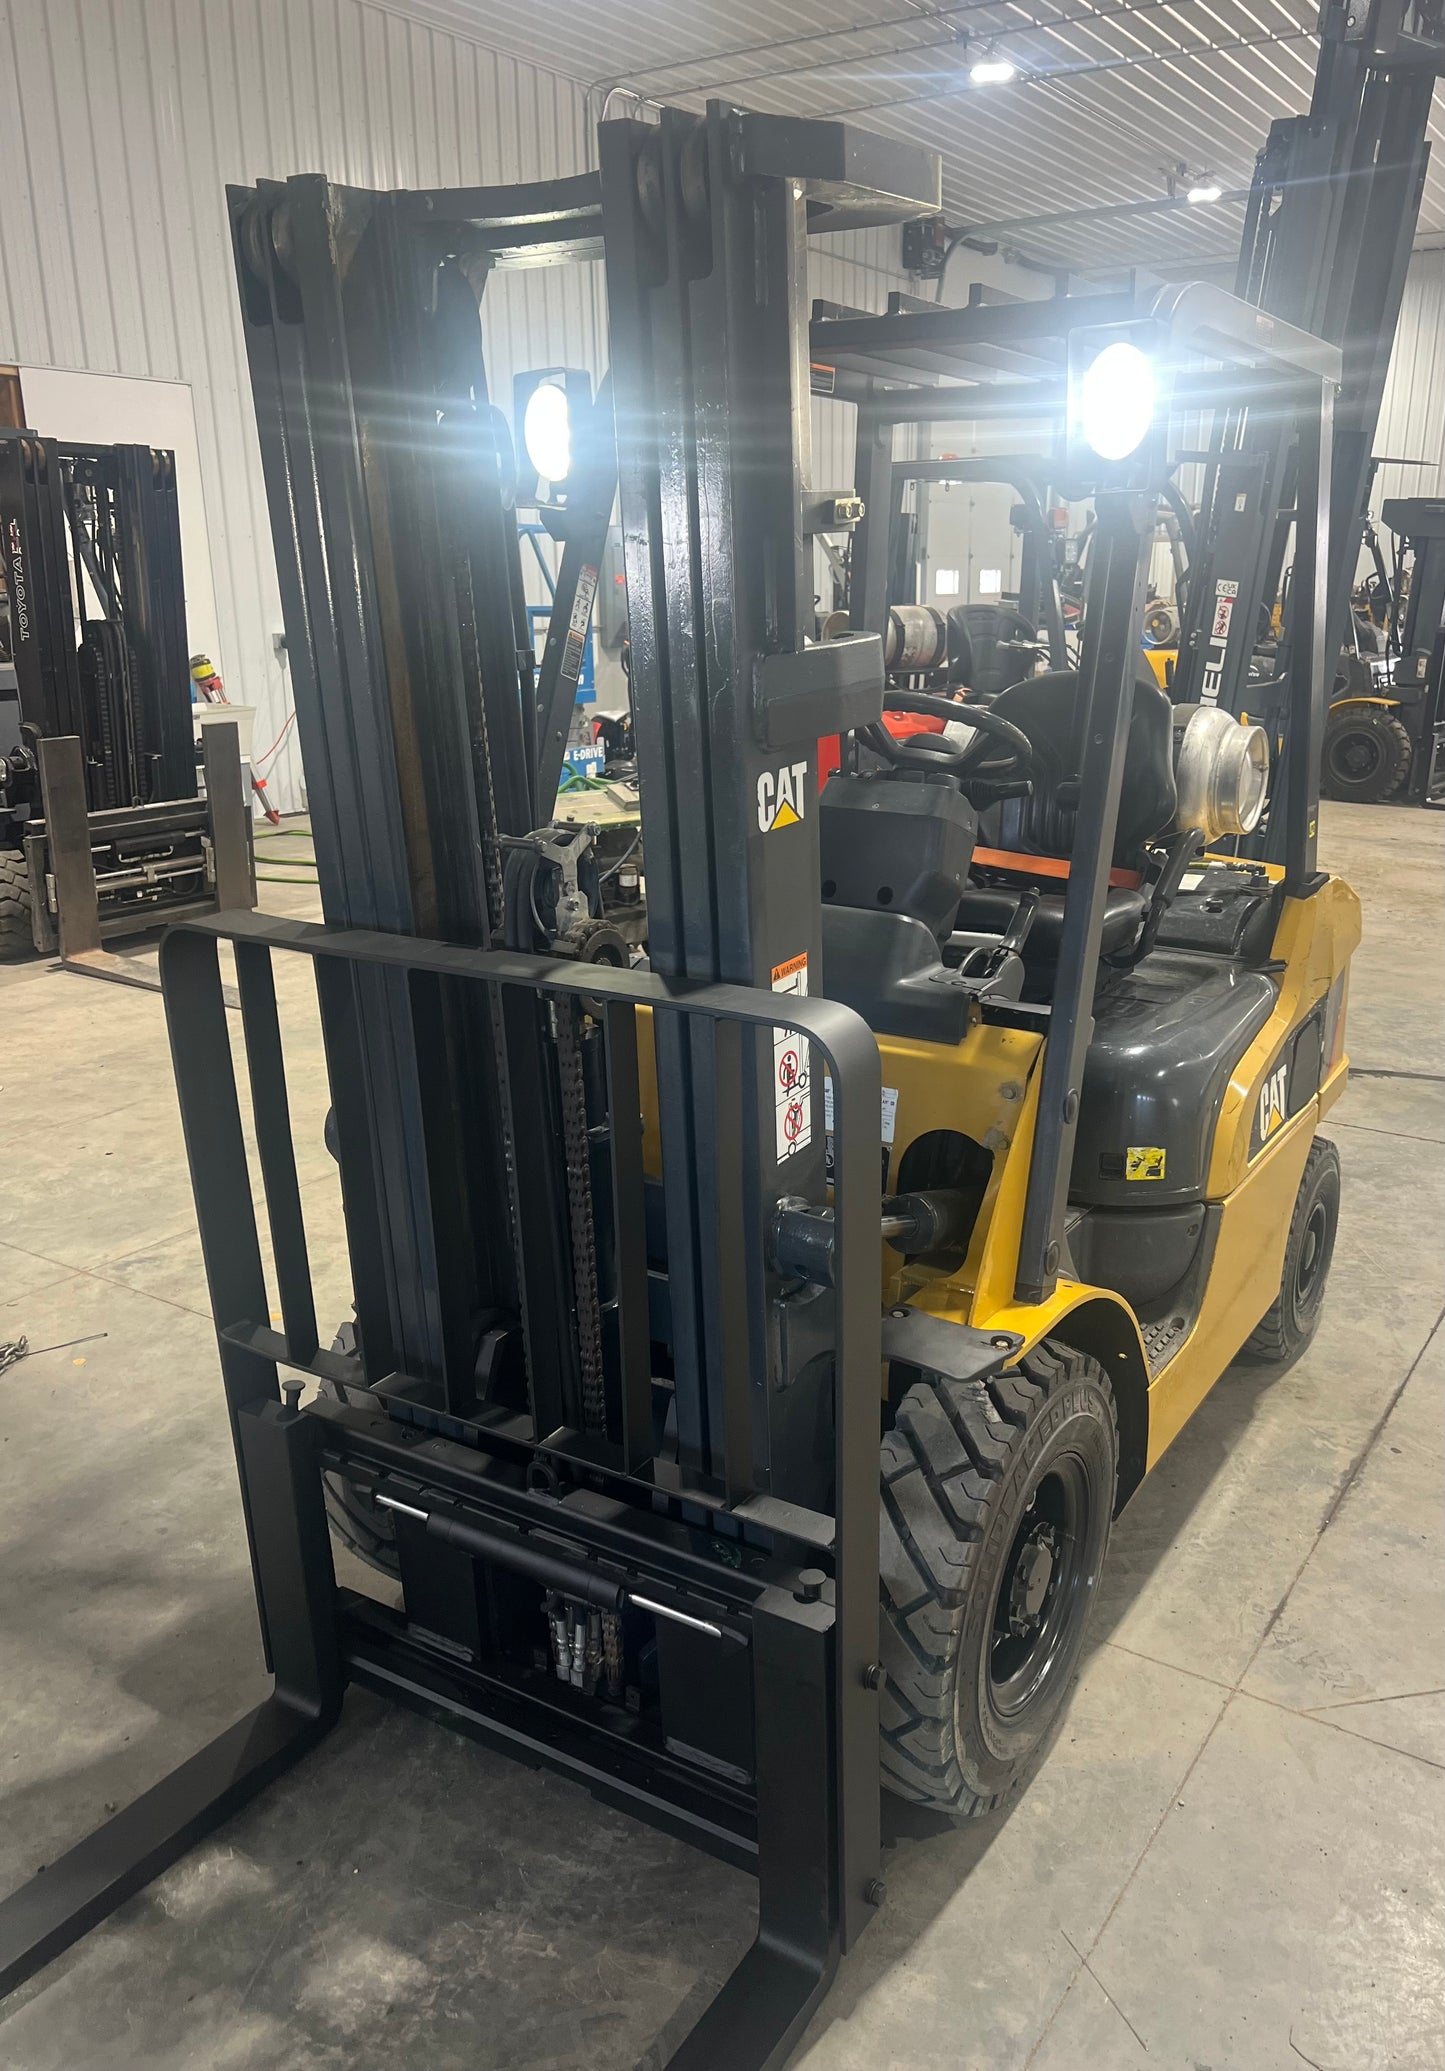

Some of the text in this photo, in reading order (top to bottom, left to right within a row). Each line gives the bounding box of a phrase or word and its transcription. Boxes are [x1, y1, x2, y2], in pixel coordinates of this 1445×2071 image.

[12, 556, 30, 641] TOYOTA
[573, 747, 604, 761] E-DRIVE
[757, 760, 808, 833] CAT
[780, 956, 807, 977] WARNING
[1259, 1063, 1288, 1142] CAT
